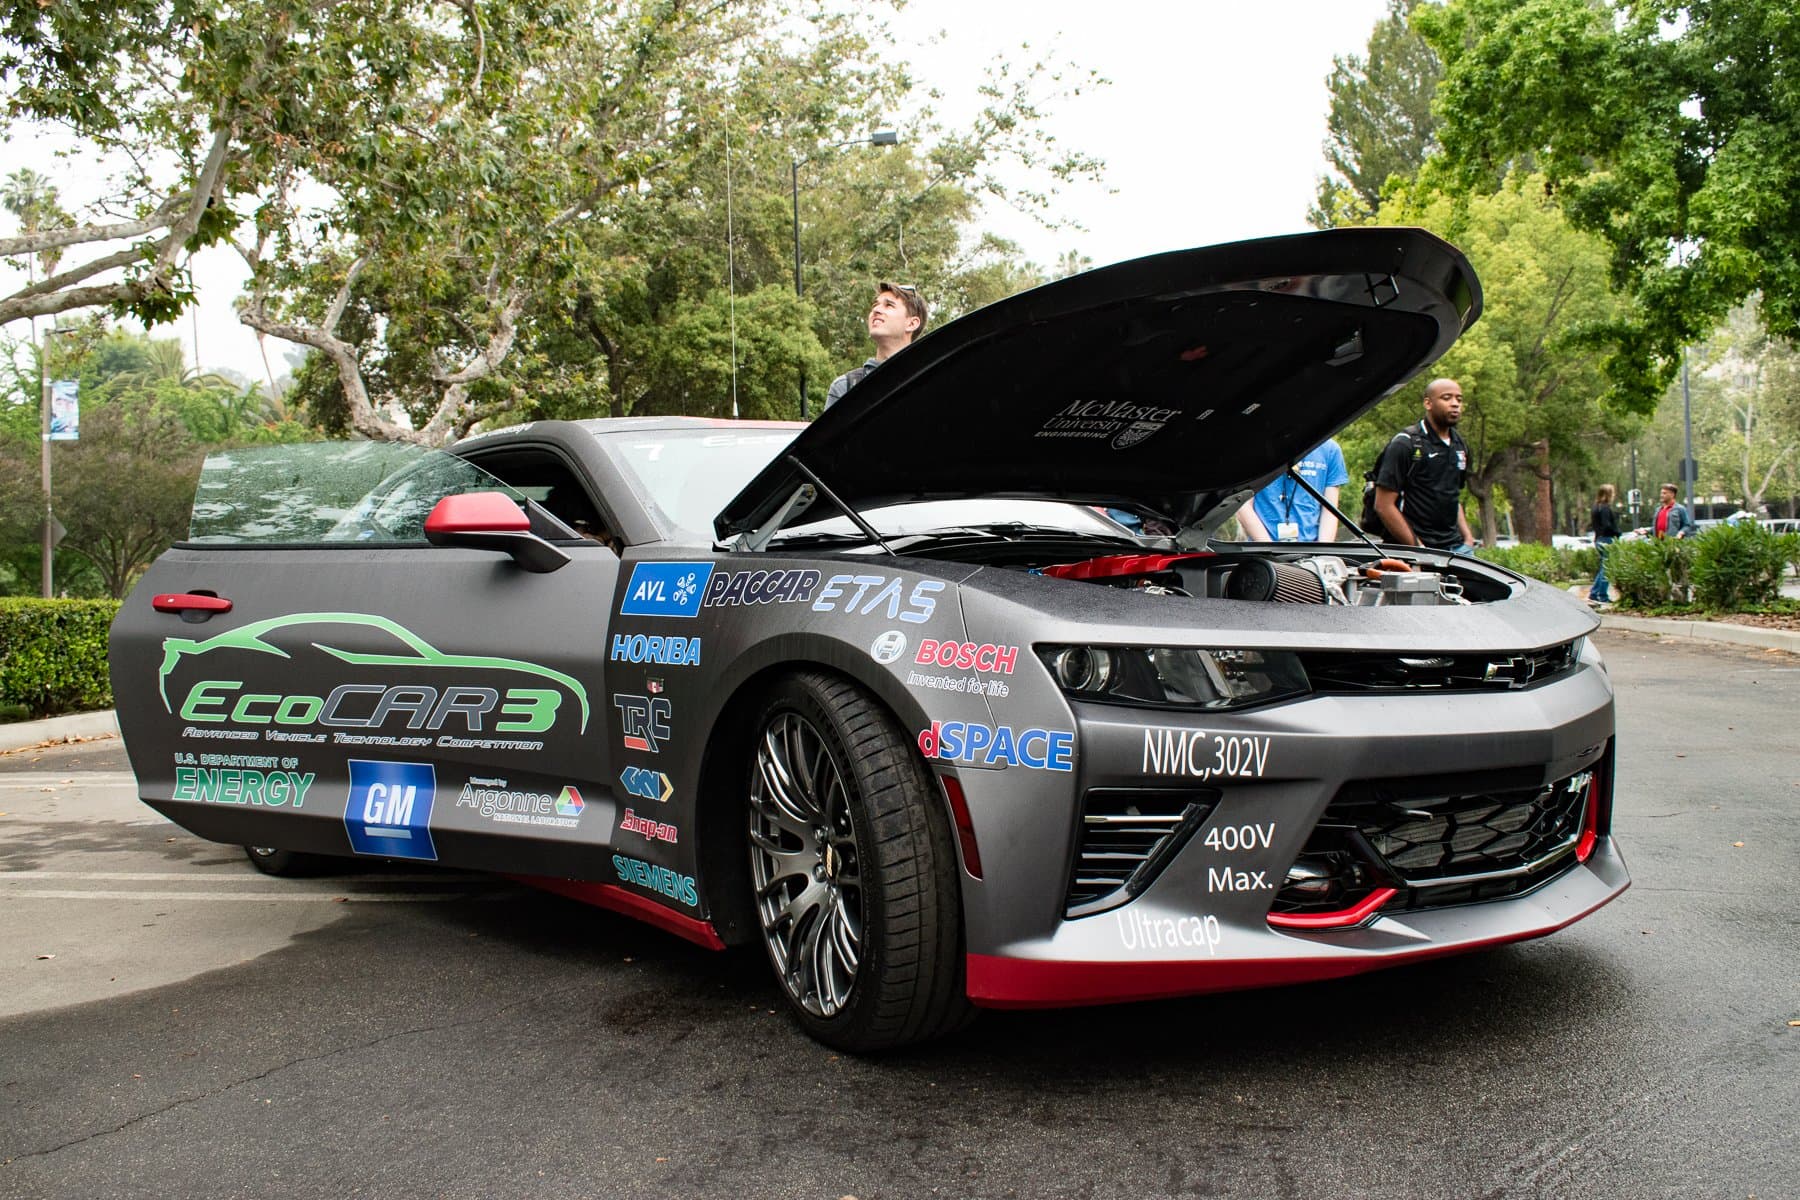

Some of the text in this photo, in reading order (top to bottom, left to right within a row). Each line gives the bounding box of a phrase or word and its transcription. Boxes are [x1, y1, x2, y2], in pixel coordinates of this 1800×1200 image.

[1042, 417, 1128, 433] University
[1056, 400, 1182, 422] McMaster
[1033, 431, 1110, 439] ENGINEERING
[633, 580, 666, 602] AVL
[704, 569, 821, 607] PACCAR
[812, 574, 946, 624] ETAS
[610, 634, 701, 666] HORIBA
[915, 639, 1019, 674] BOSCH
[906, 671, 1010, 697] Invented for life
[614, 694, 671, 753] TRC
[174, 753, 299, 769] U.S. DEPARTMENT OF
[918, 720, 1074, 772] dSPACE
[1142, 729, 1270, 782] NMC,302V
[172, 767, 316, 808] ENERGY
[363, 782, 416, 826] GM
[456, 782, 552, 817] Argonne
[620, 808, 678, 843] Snap-on
[1204, 823, 1276, 851] 400V
[612, 854, 698, 907] SIEMENS
[1208, 866, 1273, 893] Max.
[1117, 908, 1220, 956] Ultracap
